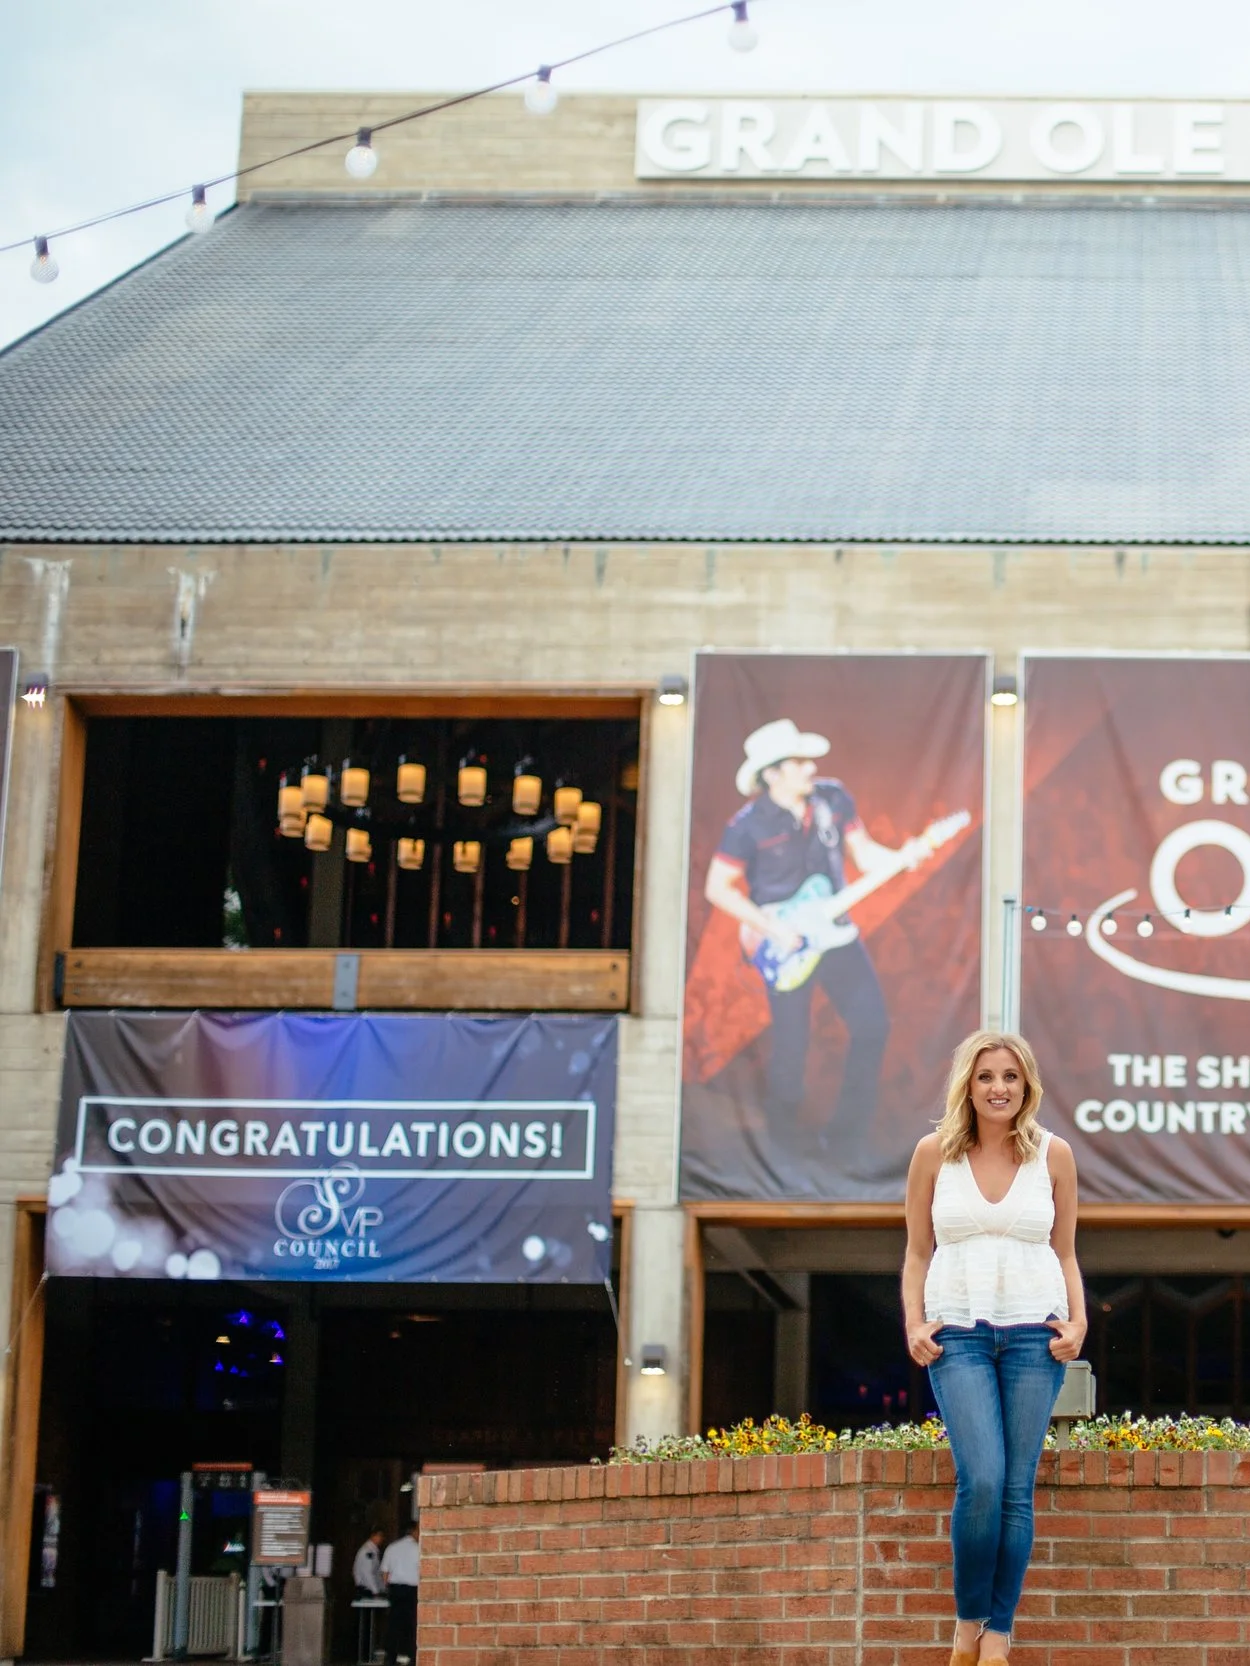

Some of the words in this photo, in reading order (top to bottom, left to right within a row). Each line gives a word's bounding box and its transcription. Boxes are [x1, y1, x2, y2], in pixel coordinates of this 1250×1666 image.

[640, 101, 1002, 173] GRAND
[1028, 102, 1226, 174] OLE
[1107, 1054, 1187, 1088] THE
[107, 1118, 564, 1158] CONGRATULATIONS!
[273, 1239, 382, 1258] COUNCIL
